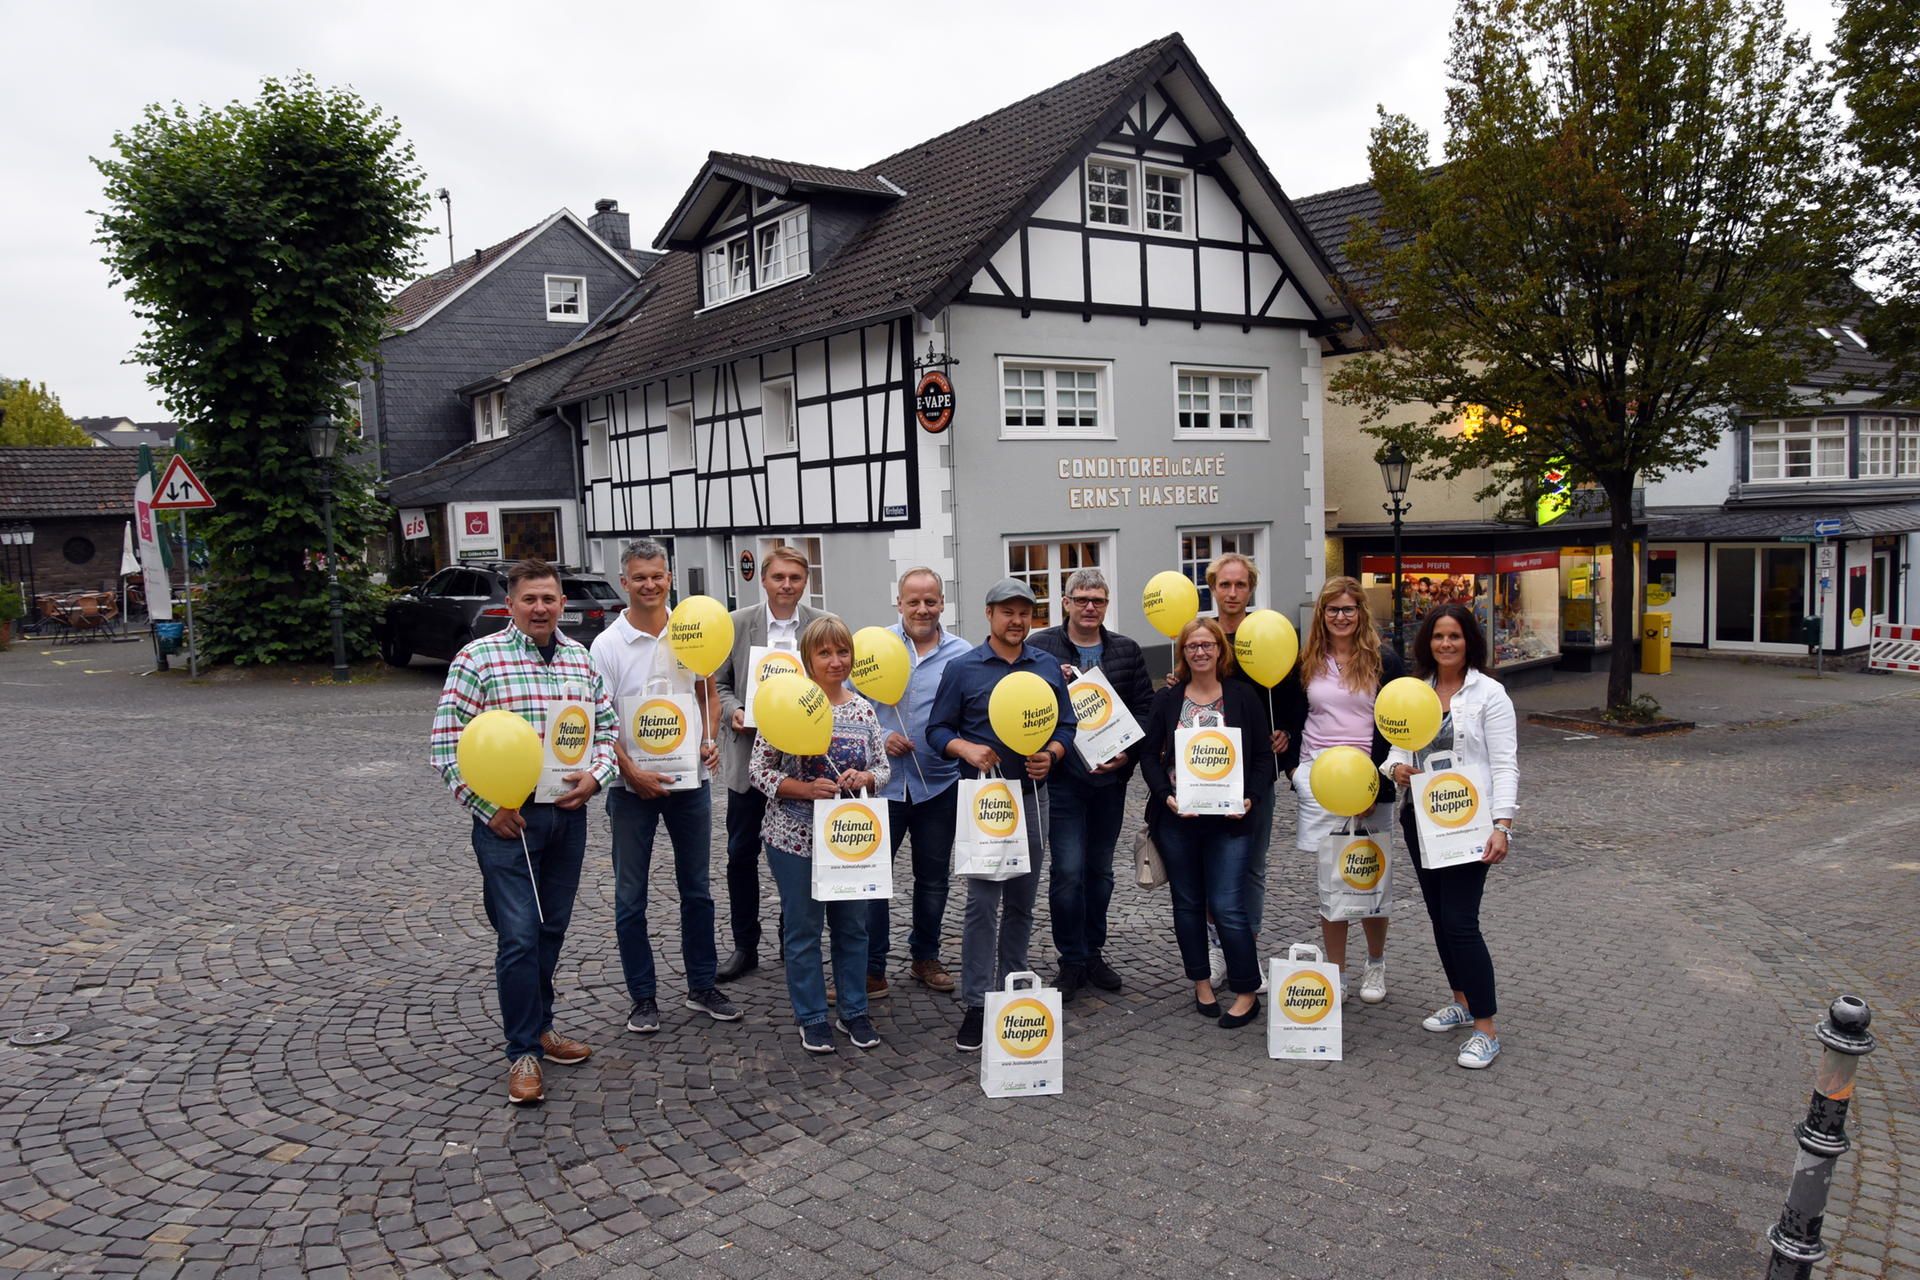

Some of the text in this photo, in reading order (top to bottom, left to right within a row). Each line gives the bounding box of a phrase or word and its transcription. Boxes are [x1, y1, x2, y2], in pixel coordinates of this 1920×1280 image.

[916, 394, 951, 410] E-VAPE
[1058, 457, 1169, 478] CONDITOREI
[1070, 485, 1219, 508] ERNST HASBERG
[1076, 697, 1108, 721] hoppen
[639, 715, 679, 727] Heimat
[559, 722, 587, 735] Heimat
[637, 727, 681, 740] shoppen
[555, 735, 586, 749] shoppen
[1191, 745, 1229, 756] Heimat
[1189, 755, 1231, 767] shoppen
[1429, 787, 1469, 803] Heimat
[1430, 798, 1474, 814] shoppen
[831, 820, 874, 832] Heimat
[830, 832, 876, 846] shoppen
[1286, 986, 1326, 997] Heimat
[1284, 997, 1328, 1009] shoppen
[1003, 1015, 1046, 1028] Heimat
[1002, 1027, 1048, 1042] shoppen
